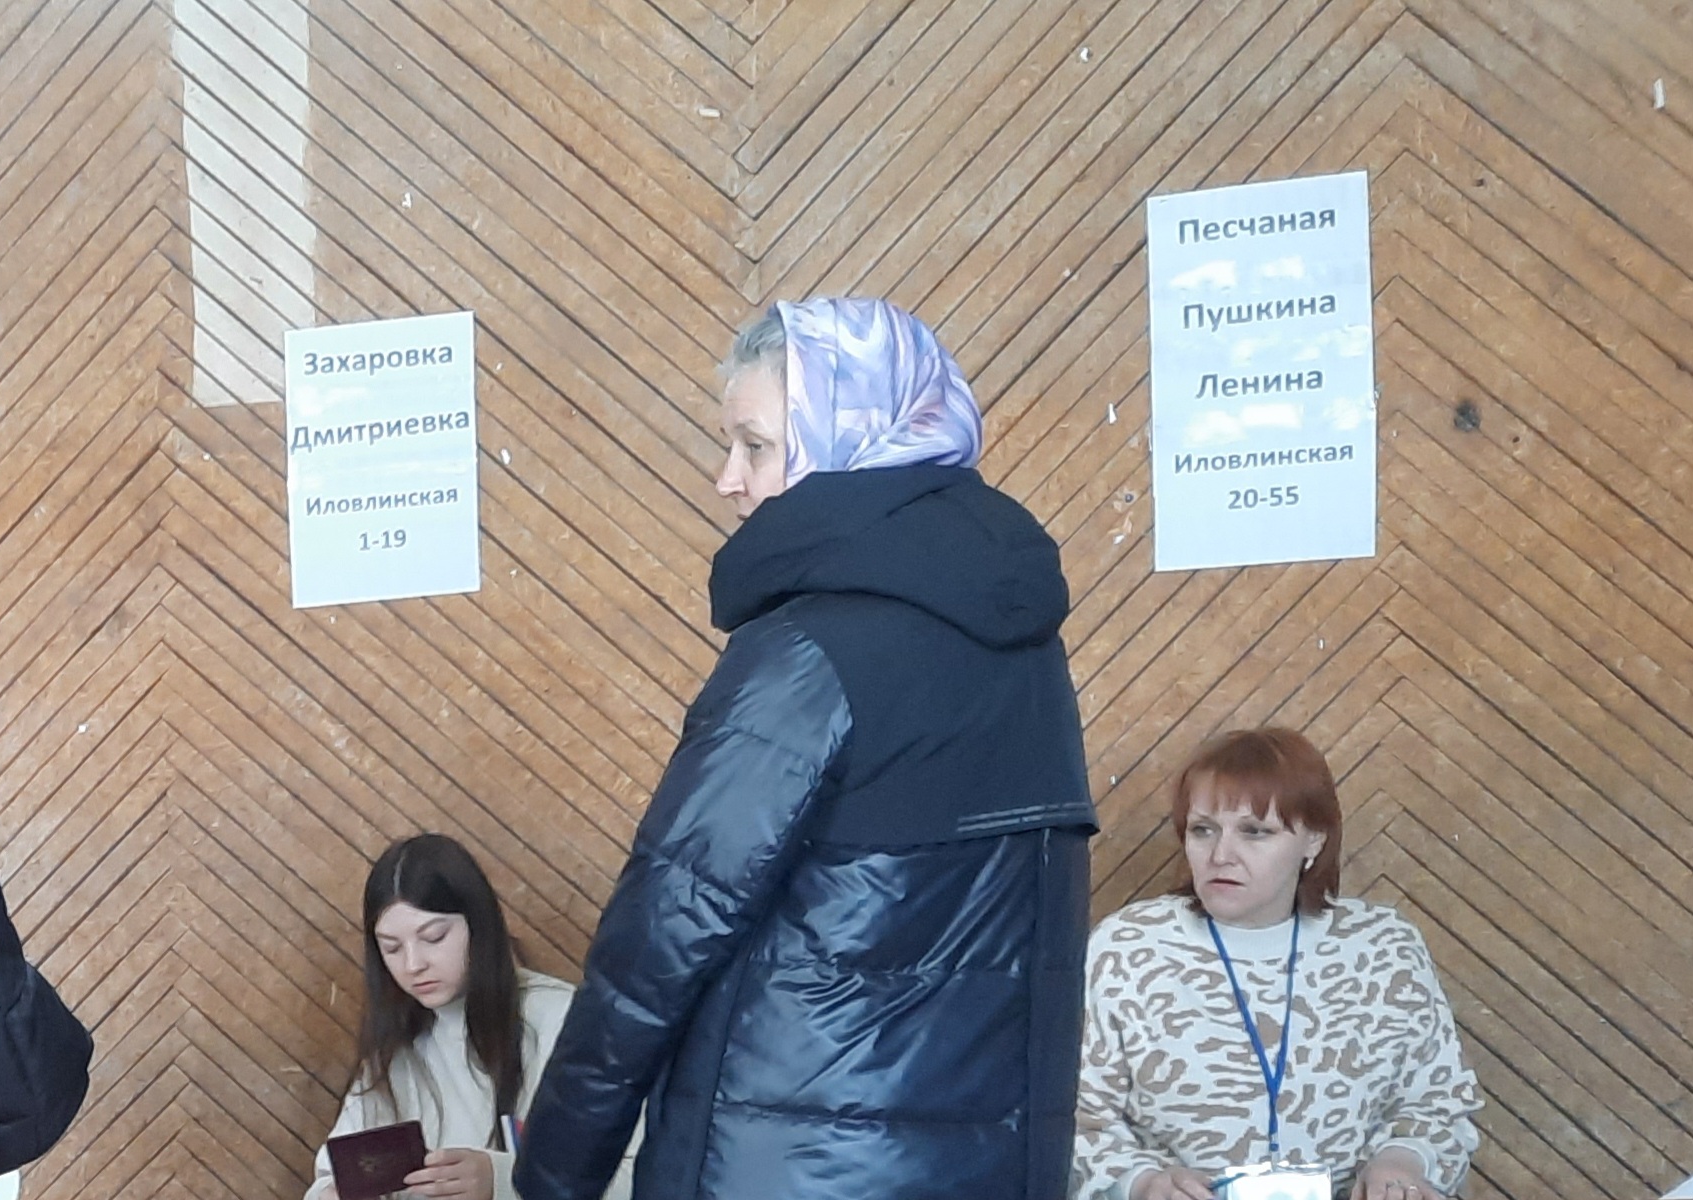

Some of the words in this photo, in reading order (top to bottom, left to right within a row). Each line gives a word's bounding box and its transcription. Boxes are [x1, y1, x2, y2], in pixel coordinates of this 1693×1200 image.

[1178, 207, 1336, 245] Песчаная
[1183, 293, 1337, 332] Пушкина
[304, 345, 453, 376] Захаровка
[1195, 369, 1323, 400] Ленина
[290, 410, 470, 454] Дмитриевка
[1174, 443, 1354, 475] Иловлинская
[306, 487, 459, 516] Иловлинская
[1228, 485, 1300, 510] 20-55
[359, 529, 407, 551] 1-19
